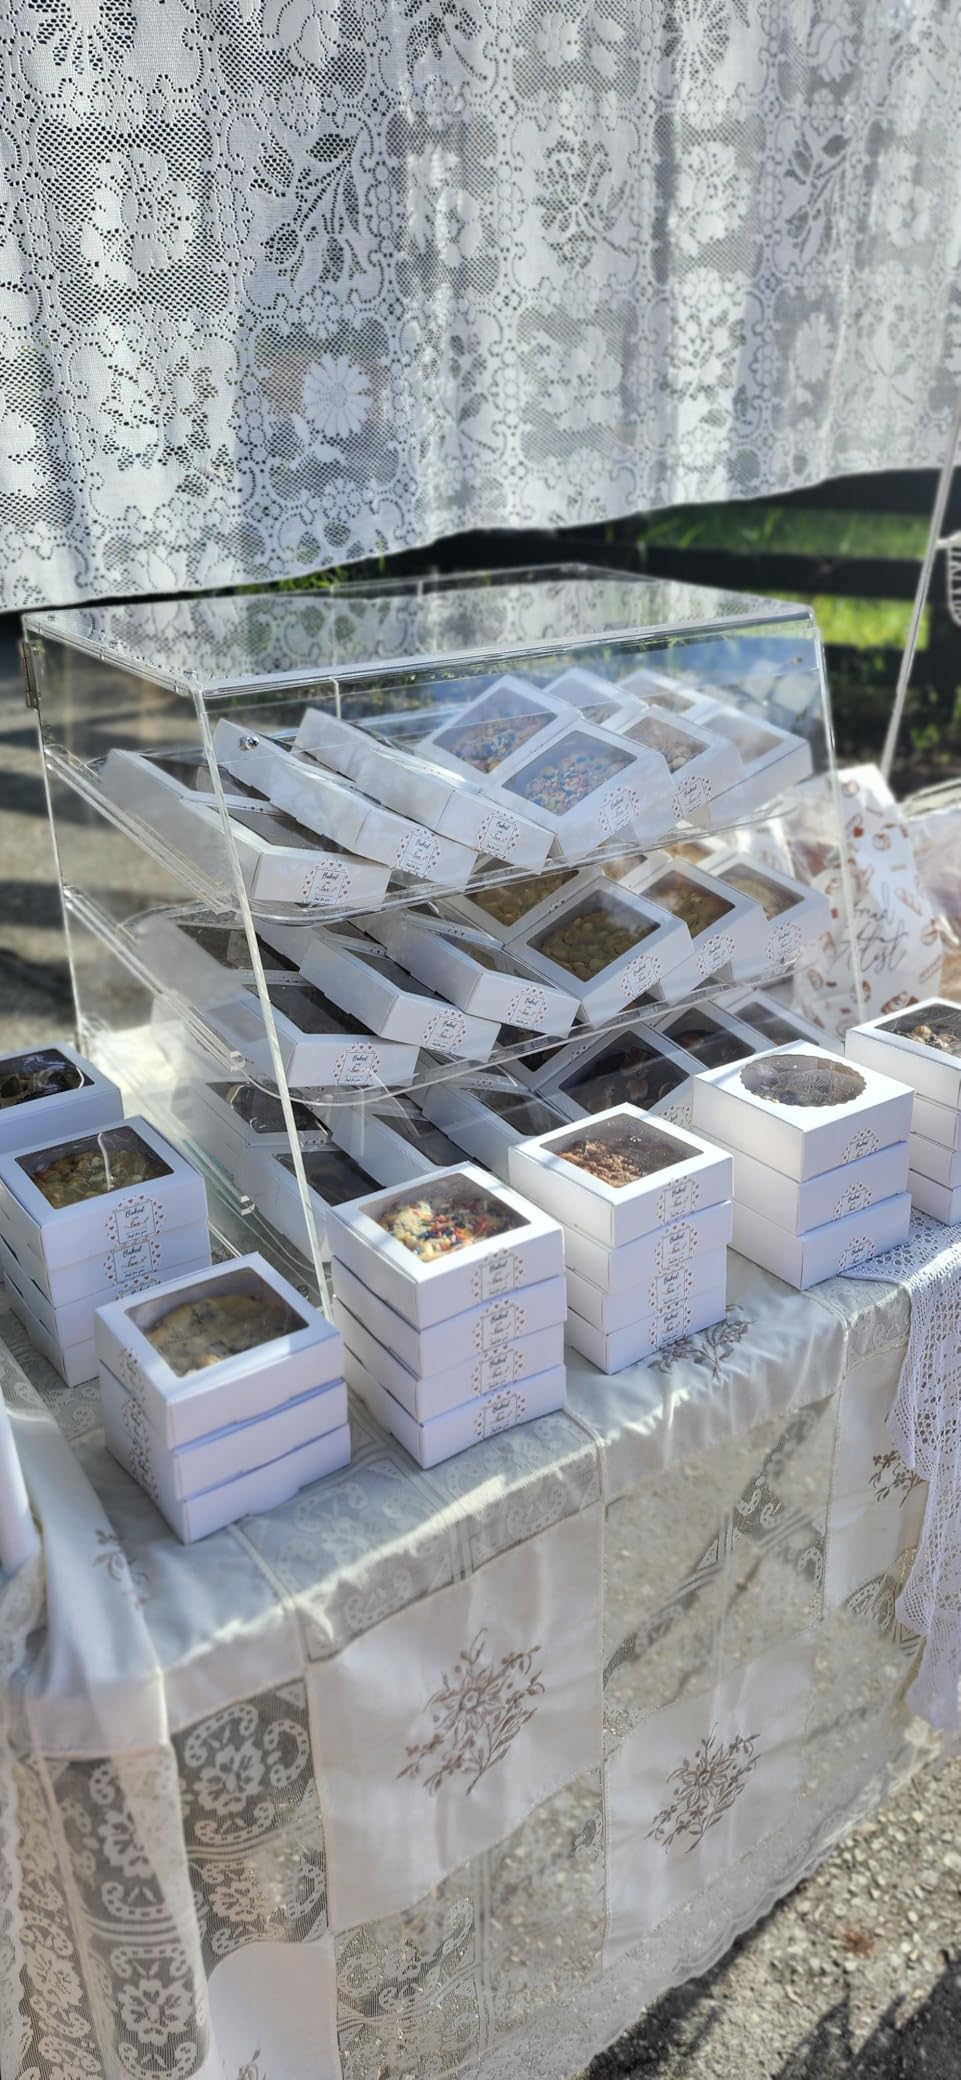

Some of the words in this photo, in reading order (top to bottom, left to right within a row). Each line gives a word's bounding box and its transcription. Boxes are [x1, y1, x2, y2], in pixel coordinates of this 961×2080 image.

[415, 839, 431, 849] Baked
[633, 964, 646, 977] Baked
[442, 1020, 457, 1028] Baked
[671, 1185, 687, 1198] Baked
[125, 1205, 145, 1217] Baked
[669, 1231, 685, 1244] Baked
[122, 1245, 142, 1258] Baked
[489, 1260, 508, 1273] Baked
[663, 1272, 679, 1284] Baked
[490, 1310, 509, 1323] Baked
[663, 1312, 678, 1323] Baked
[489, 1355, 508, 1368] Baked
[492, 1400, 510, 1413] Baked
